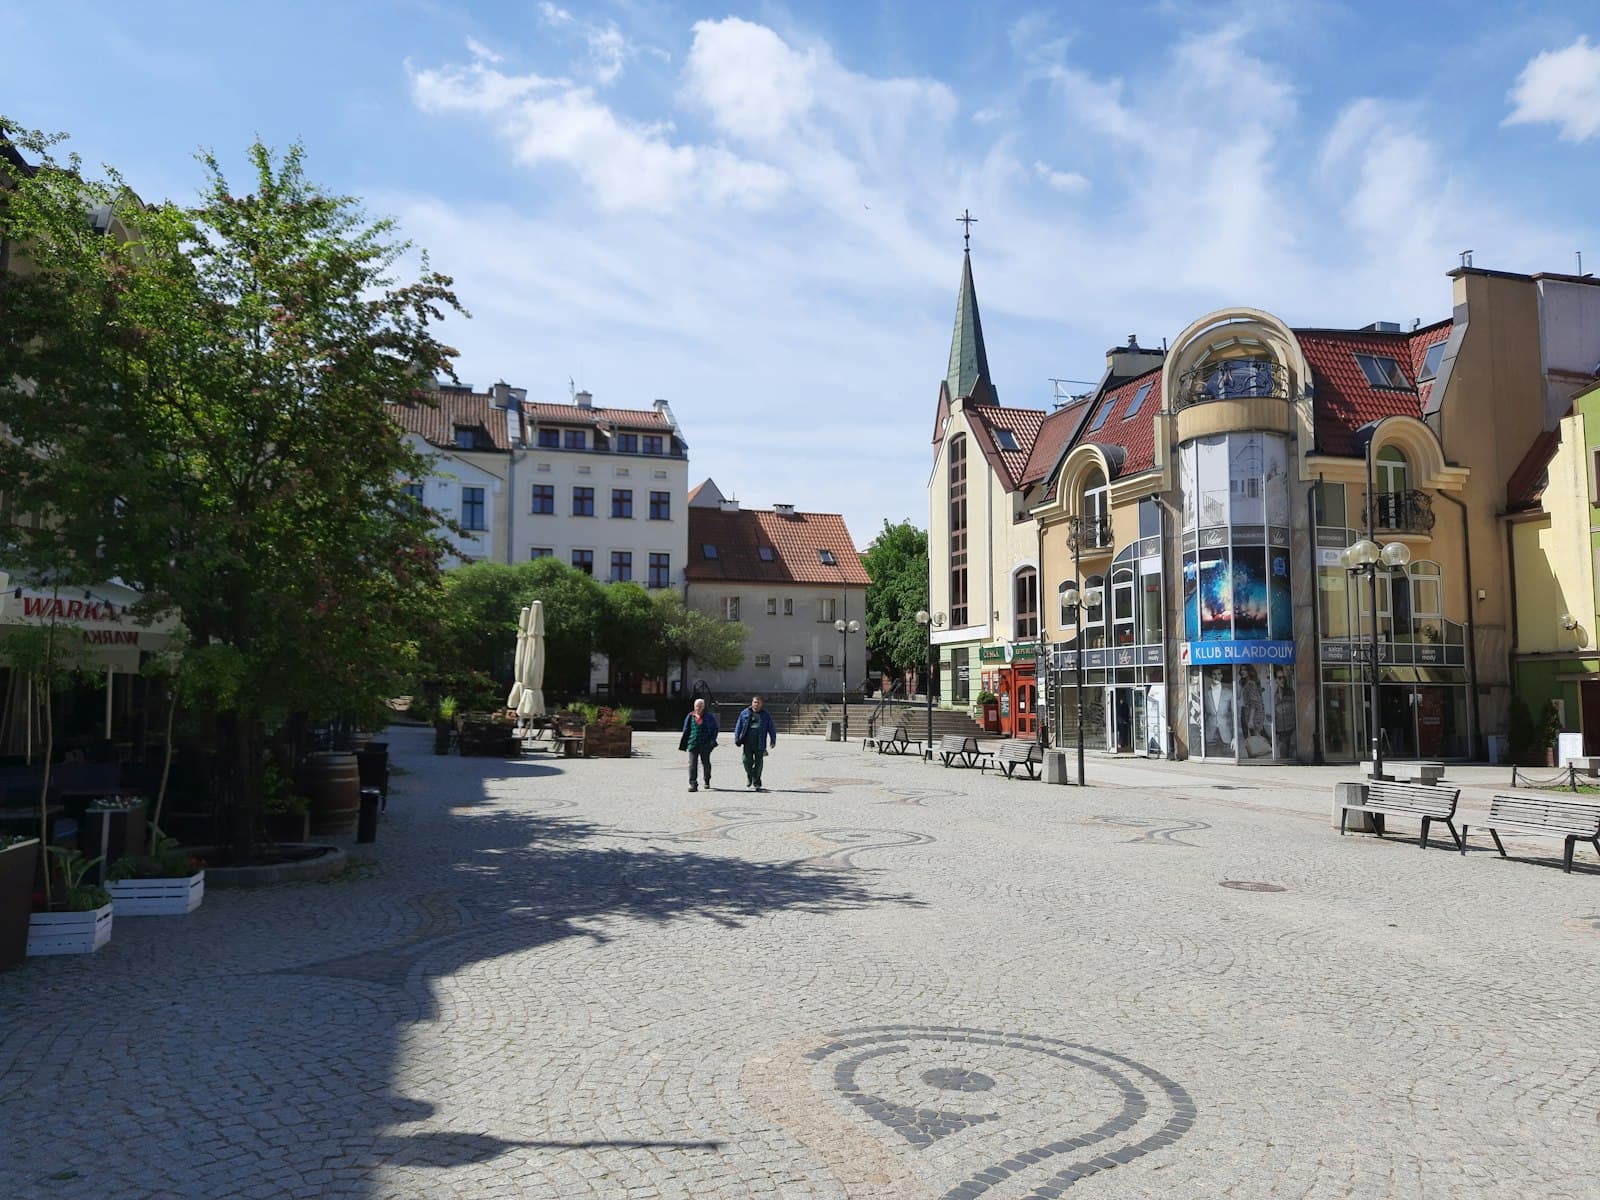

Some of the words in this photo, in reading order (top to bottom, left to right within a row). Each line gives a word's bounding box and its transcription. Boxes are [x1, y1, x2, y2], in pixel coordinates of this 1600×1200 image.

[24, 597, 116, 621] WARKA
[1195, 646, 1222, 660] KLUB
[1224, 646, 1293, 660] BILARDOWY
